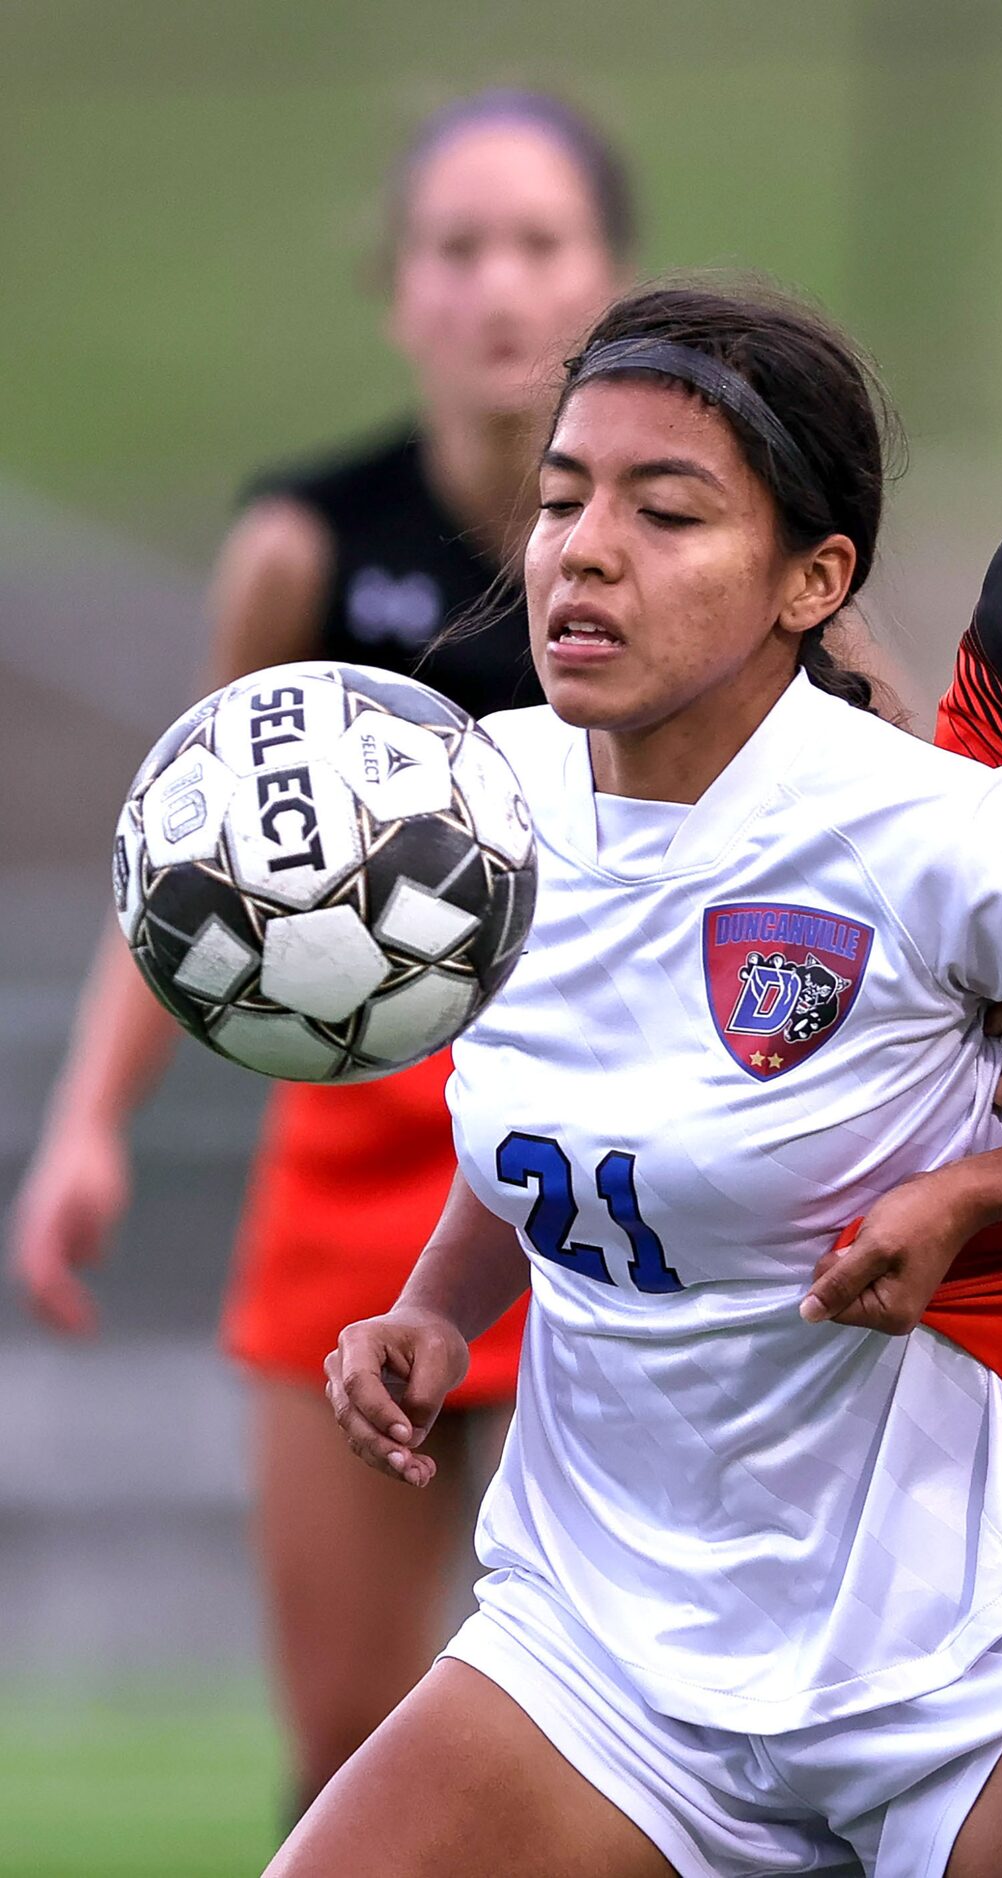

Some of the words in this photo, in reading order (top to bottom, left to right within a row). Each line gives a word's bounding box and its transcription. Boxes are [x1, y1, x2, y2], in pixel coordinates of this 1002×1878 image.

[250, 687, 326, 873] SELECT
[360, 733, 380, 785] SELECT
[715, 911, 860, 961] DUNCANVILLE
[496, 1131, 689, 1294] 21
